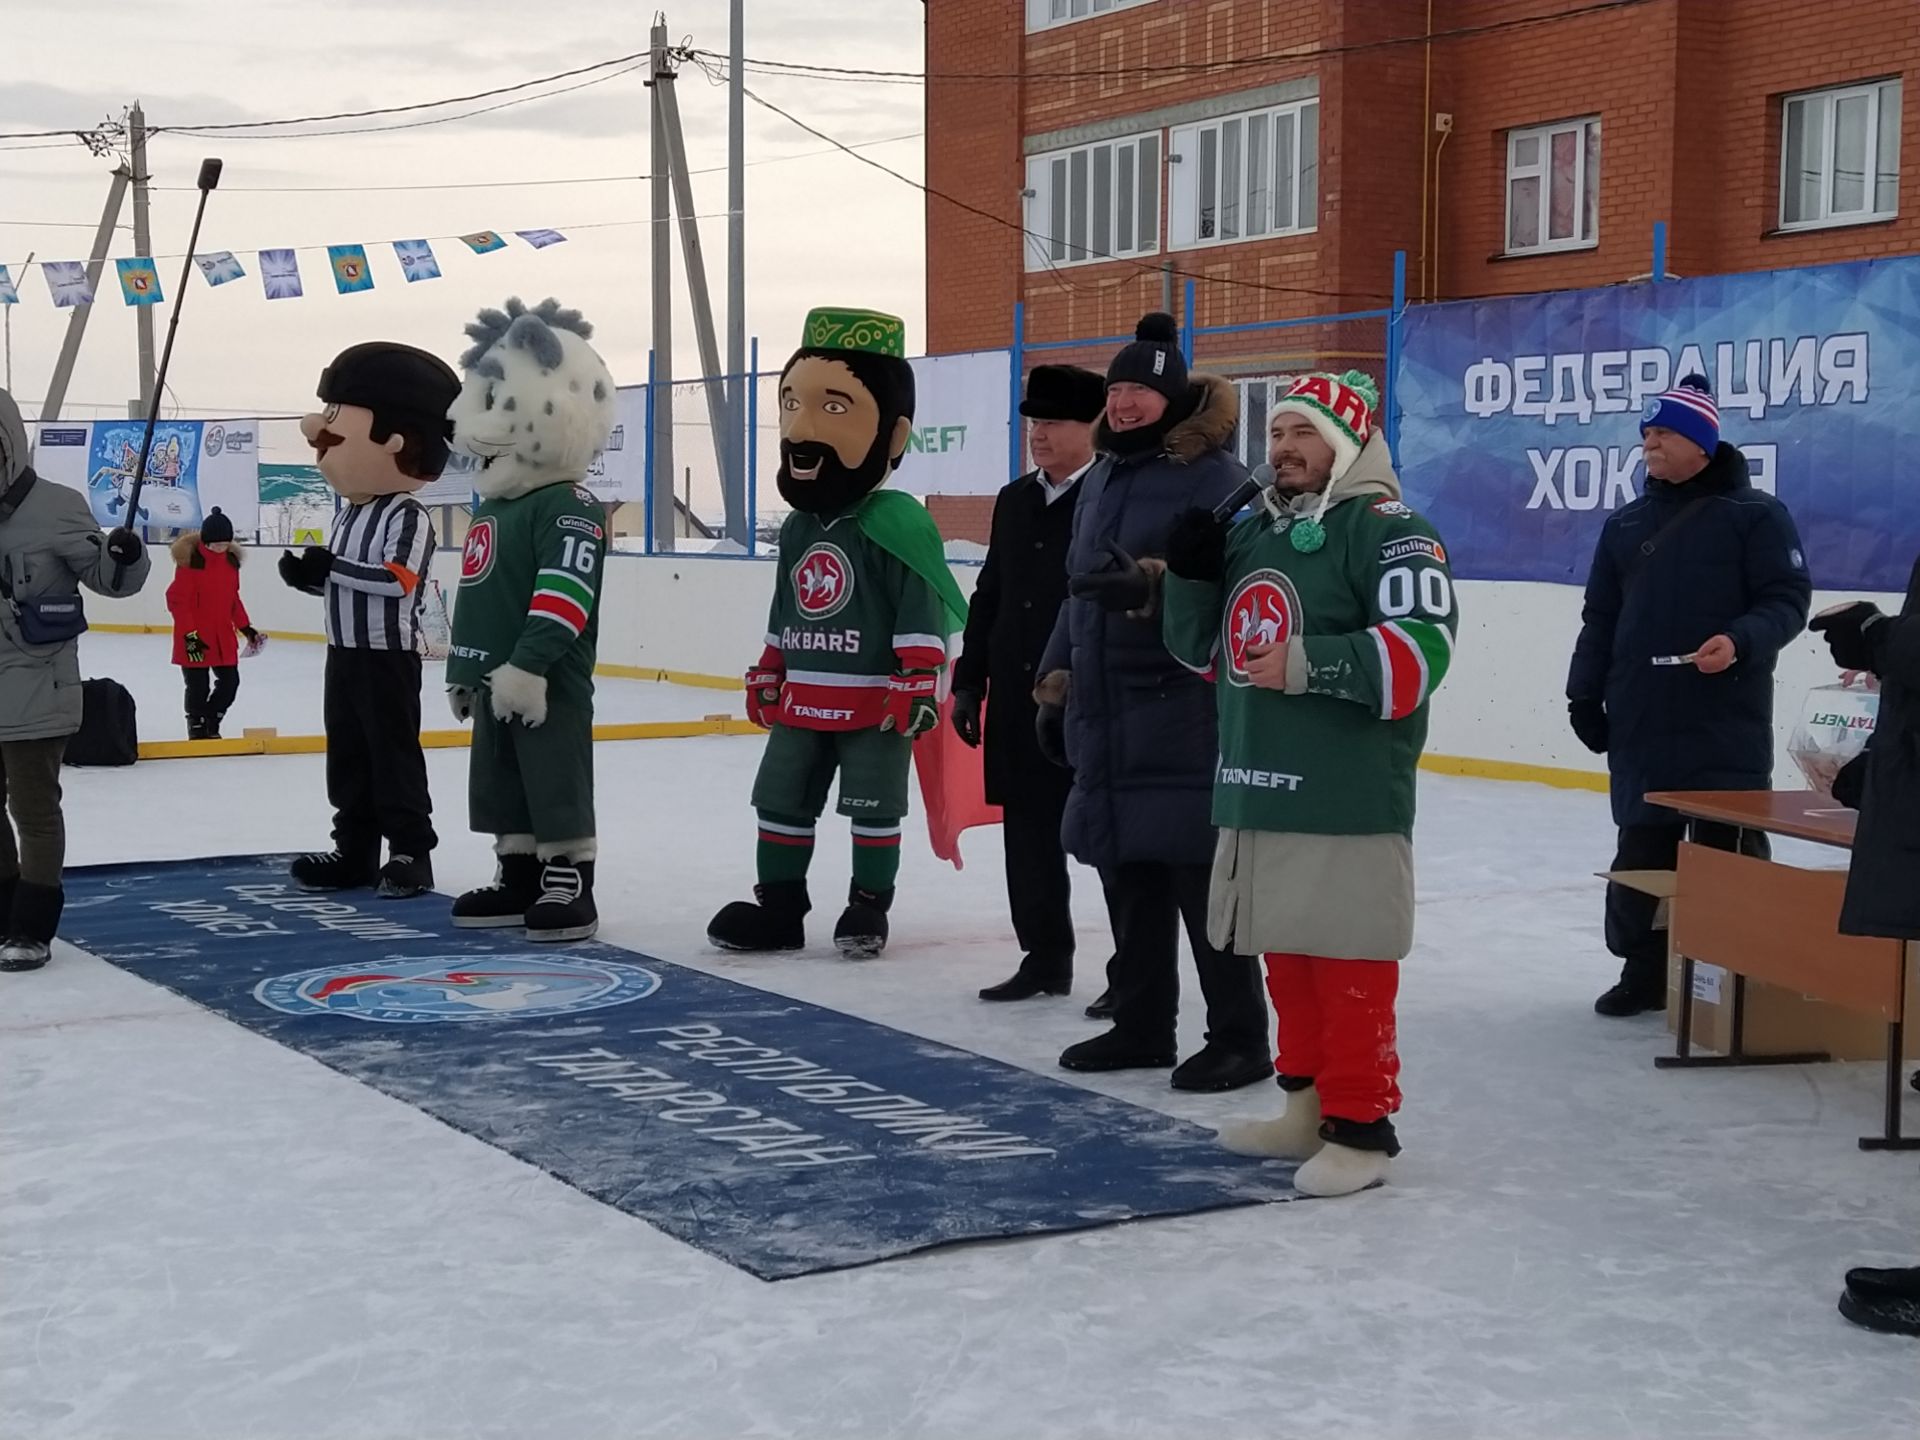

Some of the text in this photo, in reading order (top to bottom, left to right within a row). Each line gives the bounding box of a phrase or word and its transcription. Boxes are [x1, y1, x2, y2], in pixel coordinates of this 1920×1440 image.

[1464, 331, 1870, 424] ФЕДЕРАЦИЯ
[1526, 443, 1778, 511] ХОКЯ
[562, 535, 597, 574] 16
[1382, 540, 1433, 559] Winline
[1379, 566, 1451, 617] 00
[781, 626, 860, 653] AKBARS
[792, 705, 854, 720] TATNEFT
[1809, 712, 1874, 730] TATNEFT
[1222, 768, 1303, 791] TATNEFT
[842, 797, 880, 807] CCM
[524, 1047, 877, 1167] ТАТАРСТАН
[629, 1024, 1058, 1160] РЕСПУБЛИКИ
